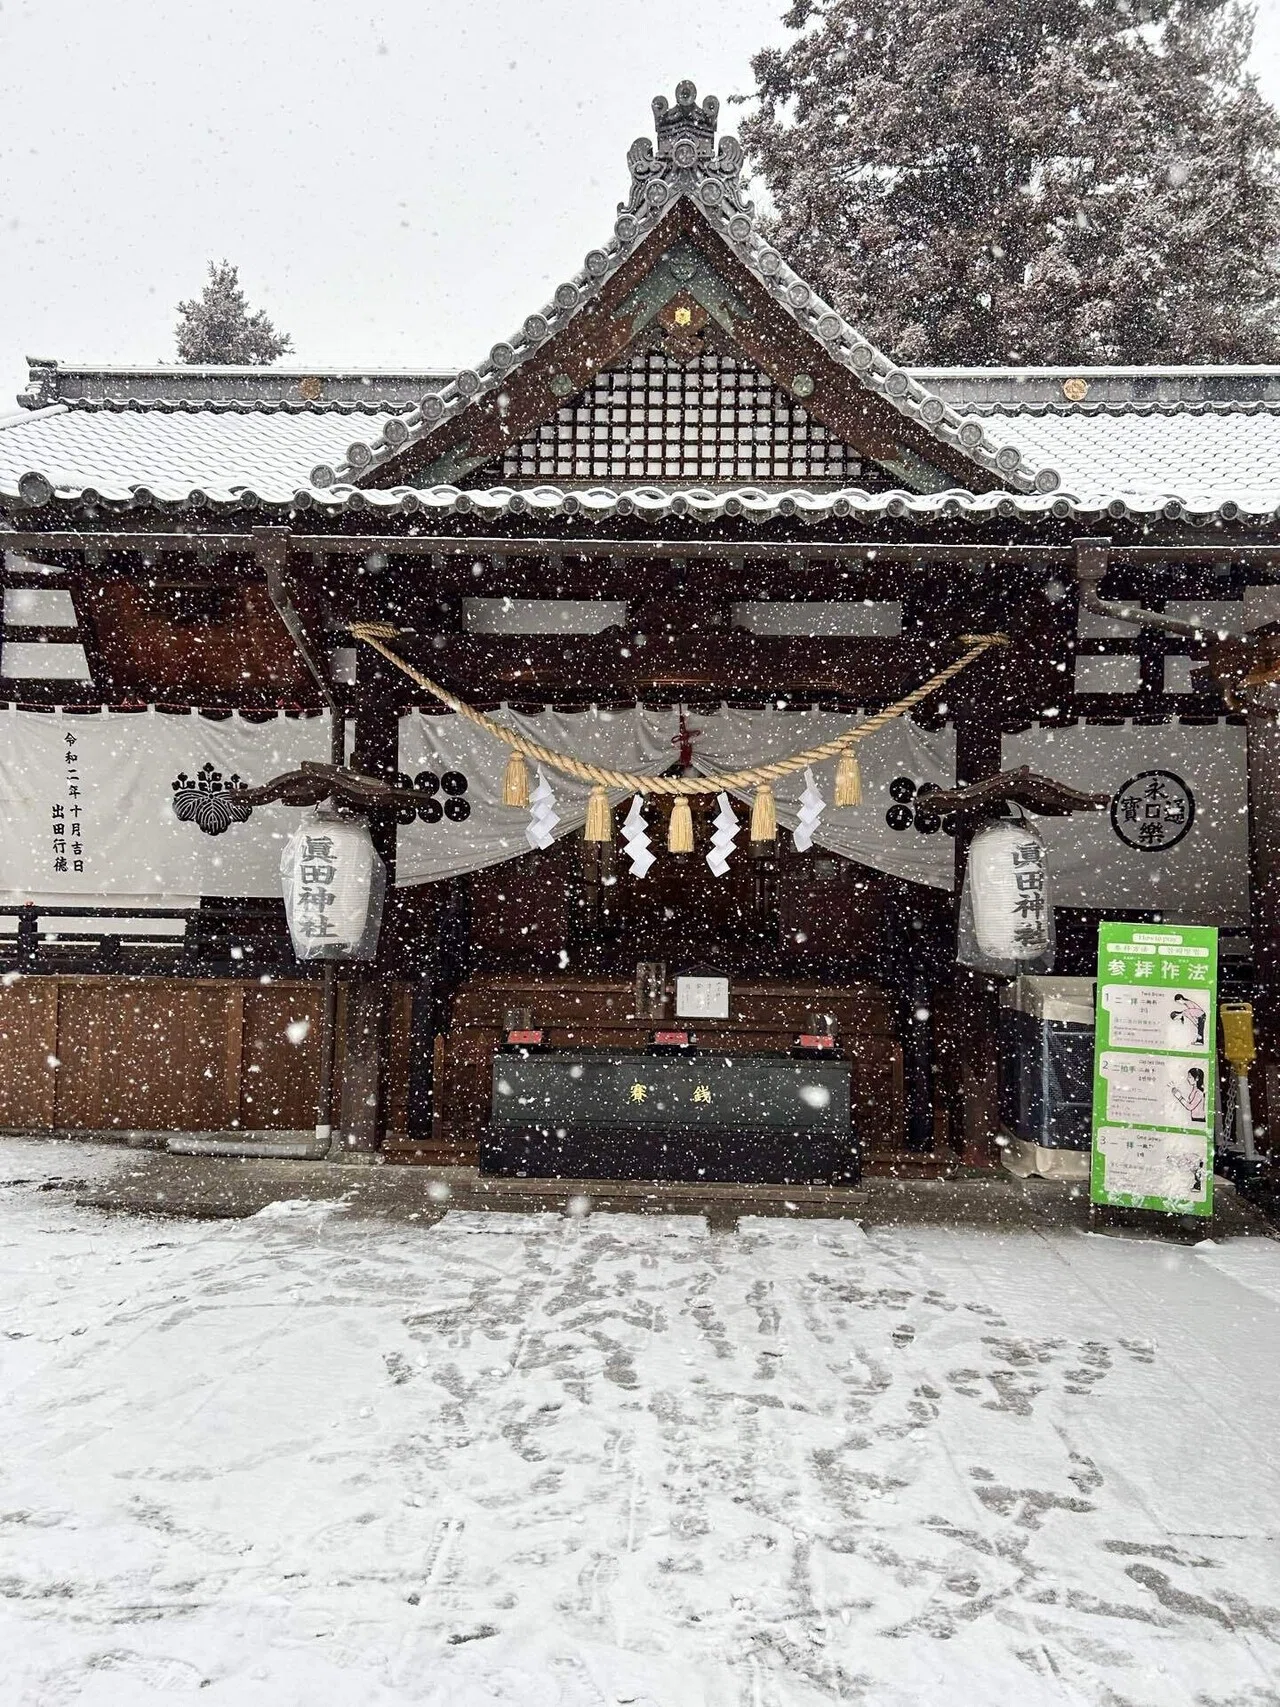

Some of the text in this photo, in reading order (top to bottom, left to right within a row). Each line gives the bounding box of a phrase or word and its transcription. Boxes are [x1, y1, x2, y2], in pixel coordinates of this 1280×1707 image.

[64, 732, 84, 873] 令和二年十月吉日
[1102, 1061, 1108, 1069] 2
[1100, 1136, 1106, 1144] 3
